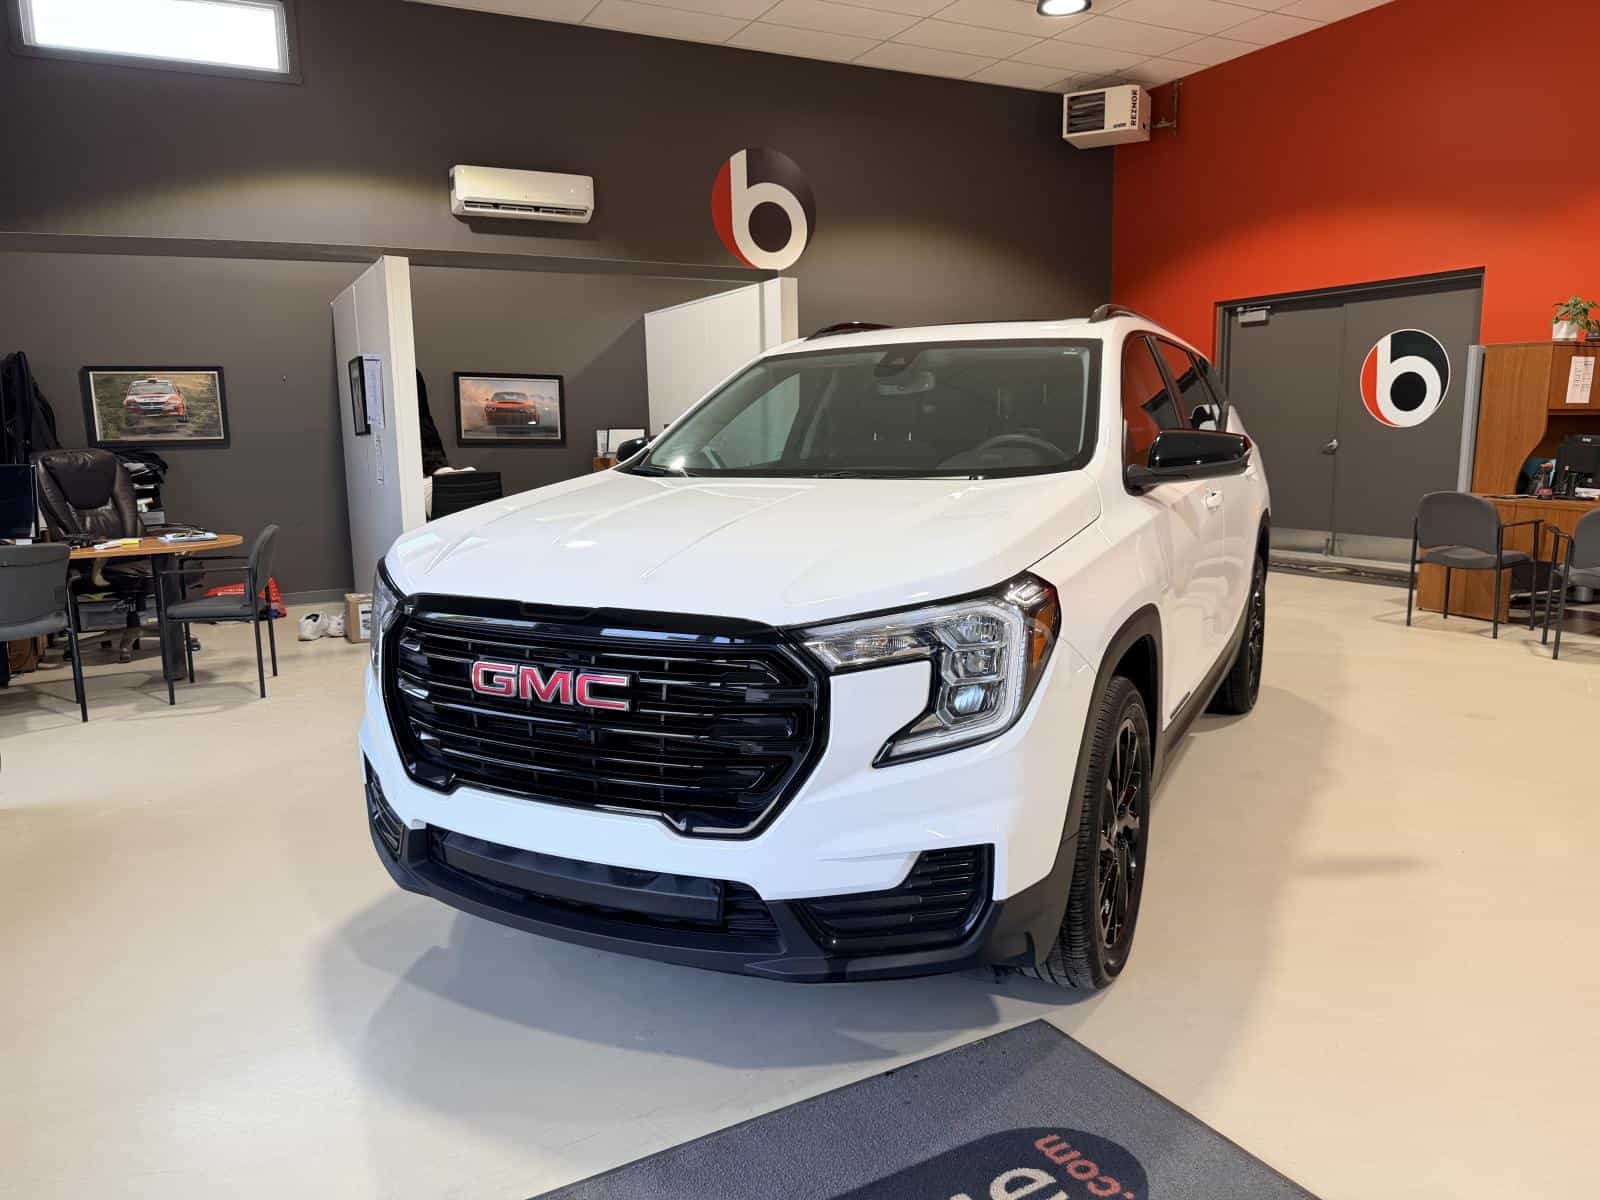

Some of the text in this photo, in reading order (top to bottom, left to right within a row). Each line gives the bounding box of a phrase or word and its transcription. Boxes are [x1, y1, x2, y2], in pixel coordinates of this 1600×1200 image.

[729, 148, 808, 271] b
[1375, 333, 1442, 428] b
[472, 661, 631, 711] GMC
